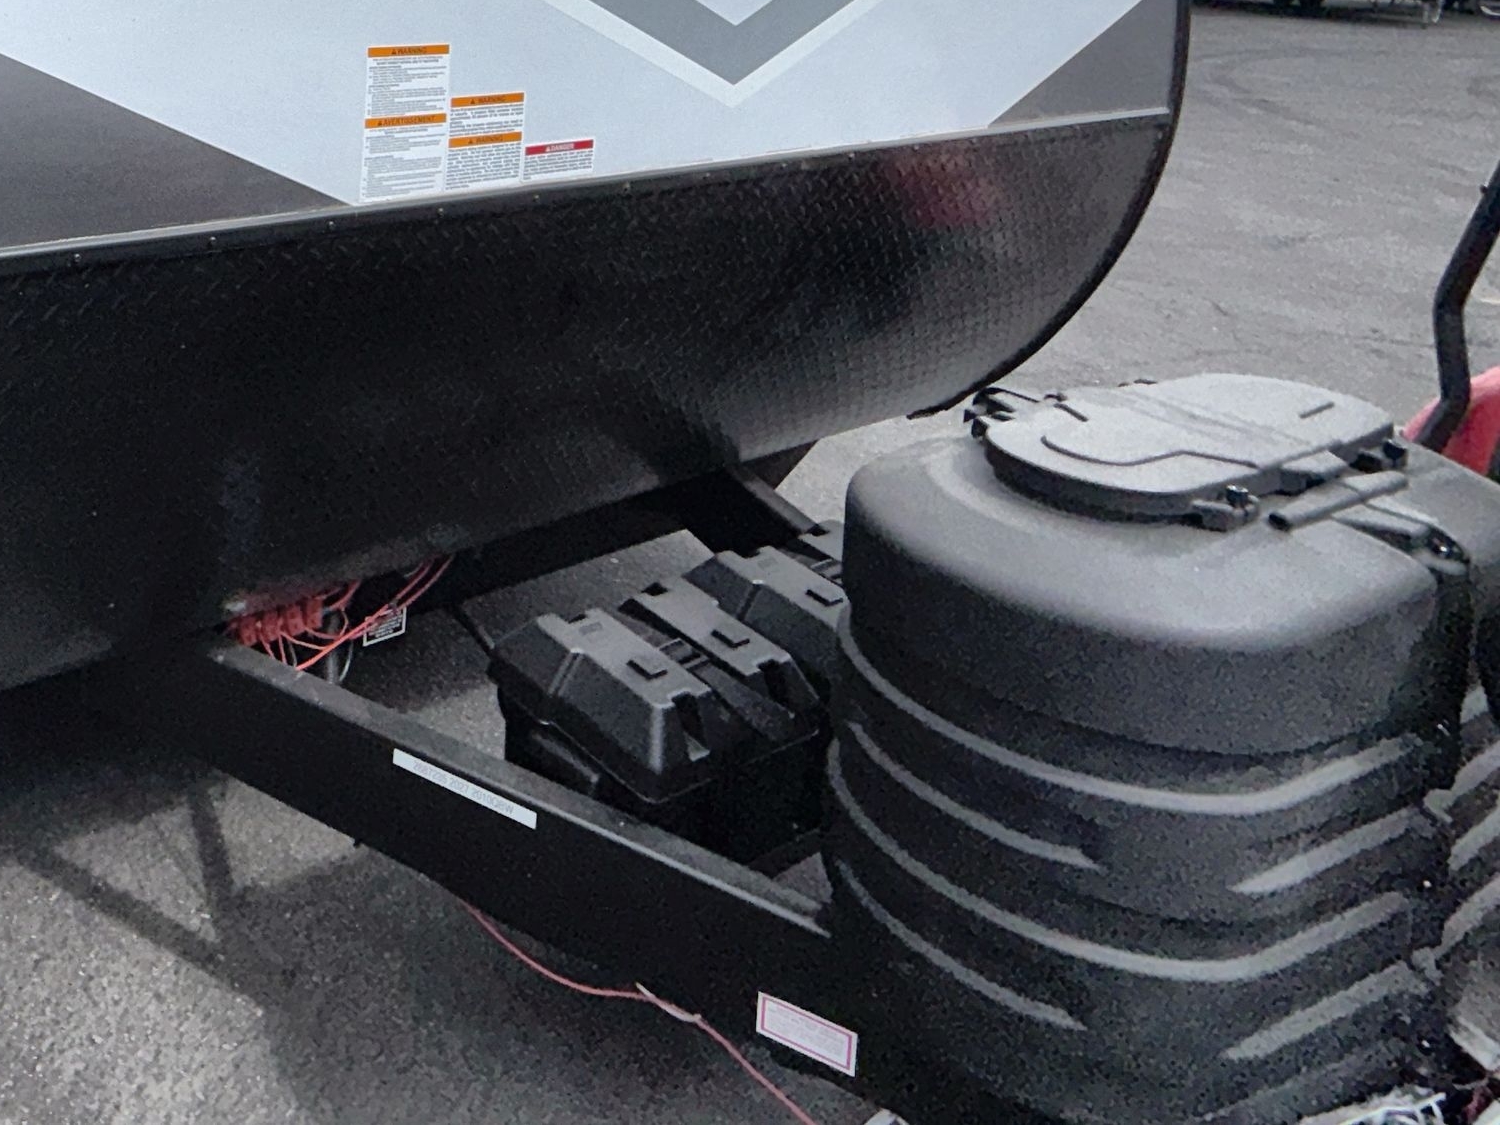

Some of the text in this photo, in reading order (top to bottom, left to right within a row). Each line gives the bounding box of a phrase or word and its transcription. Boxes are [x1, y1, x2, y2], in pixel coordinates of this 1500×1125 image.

[396, 47, 427, 55] WARNING
[382, 115, 436, 127] AVERTISSEMENT
[550, 143, 575, 152] DANGER
